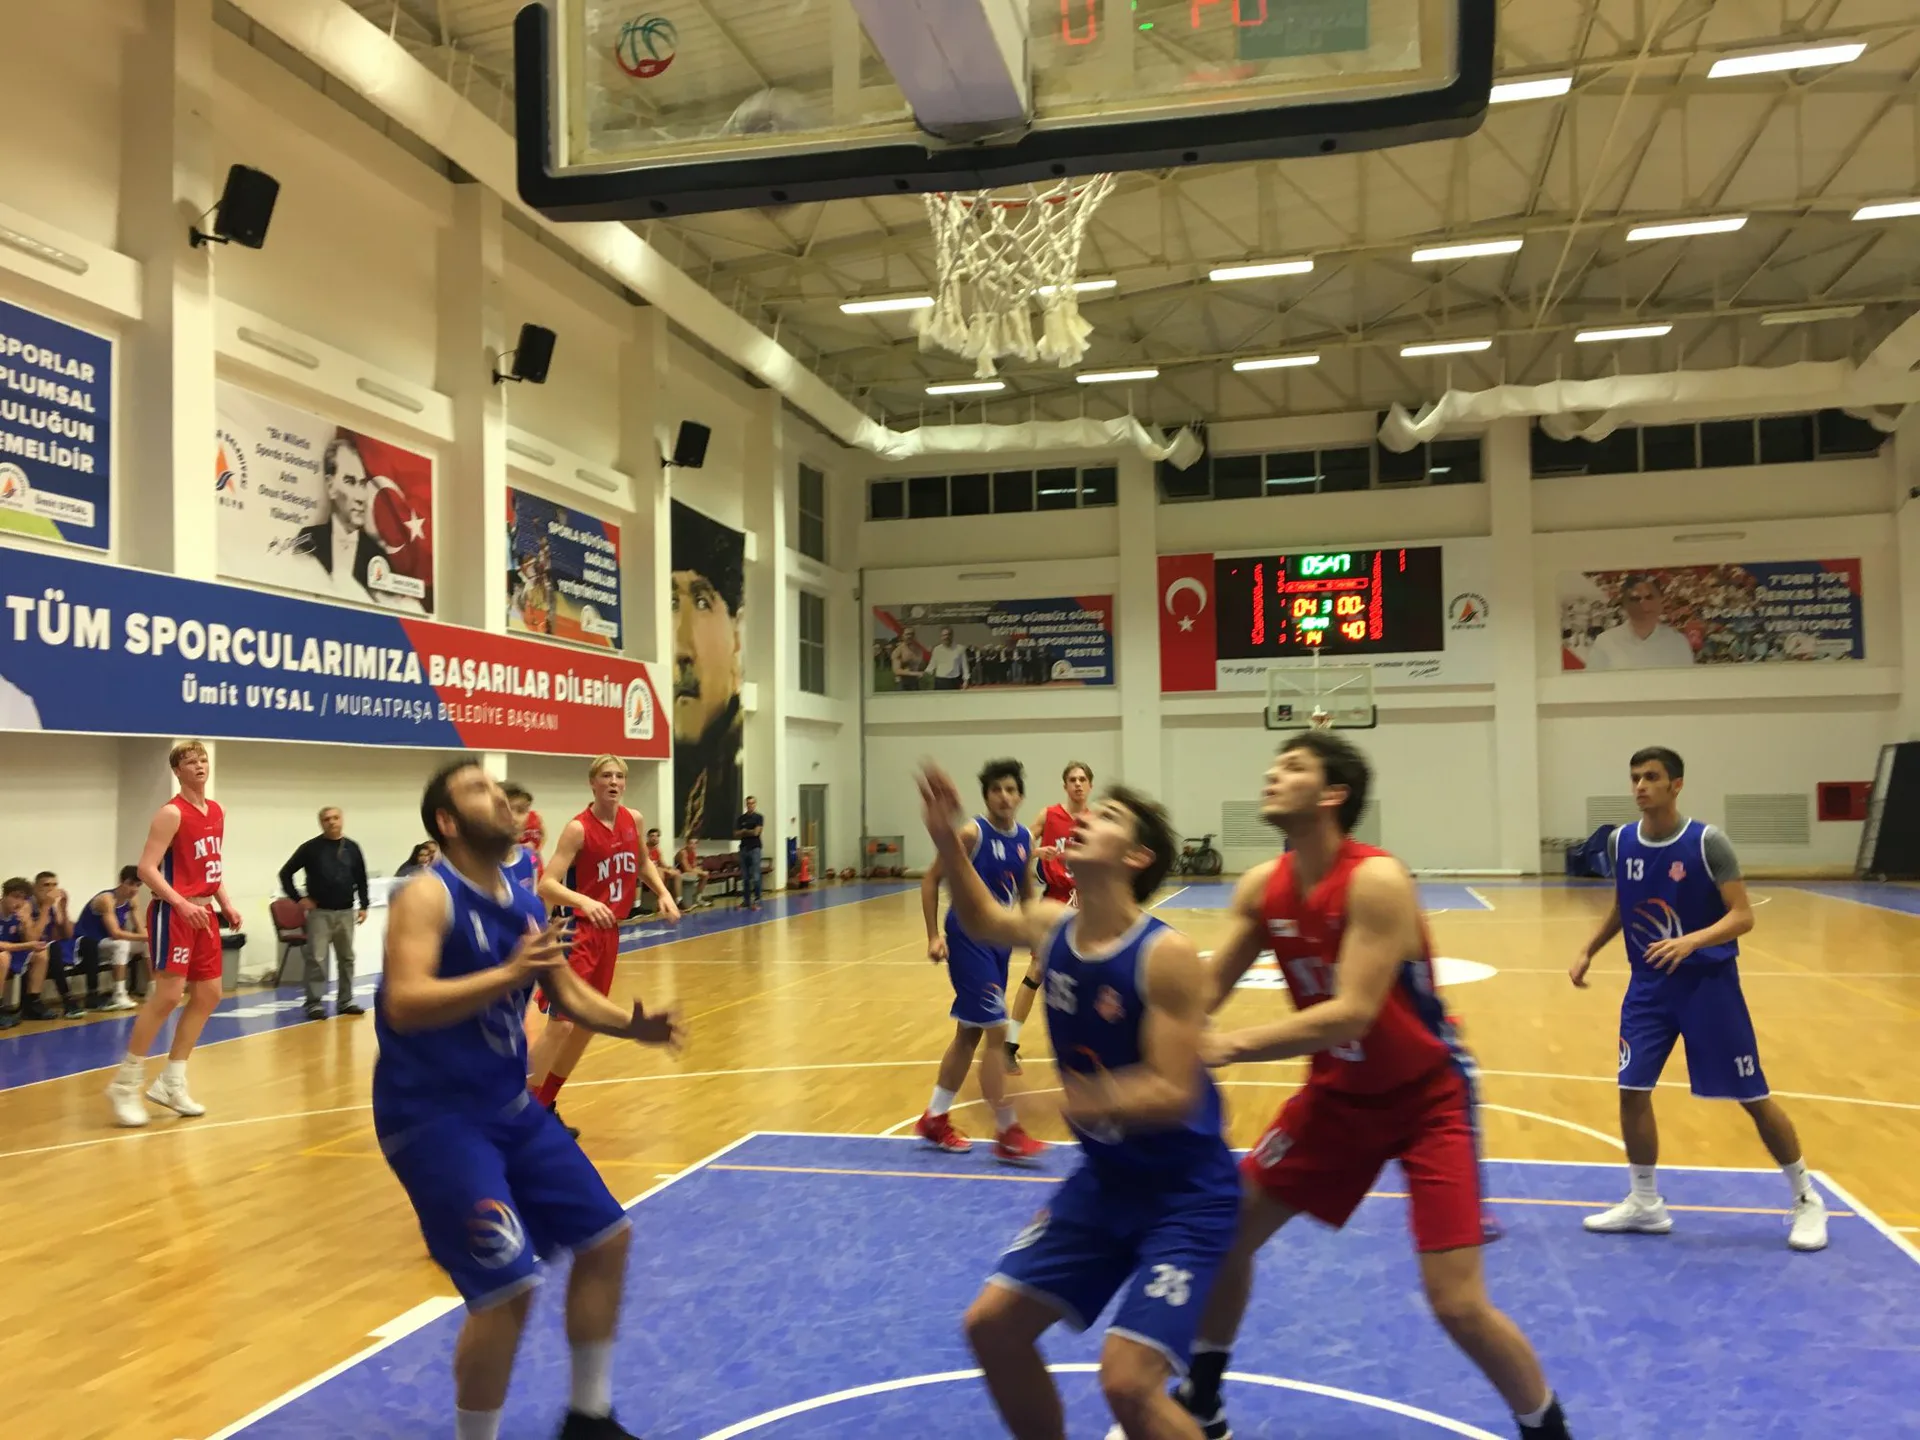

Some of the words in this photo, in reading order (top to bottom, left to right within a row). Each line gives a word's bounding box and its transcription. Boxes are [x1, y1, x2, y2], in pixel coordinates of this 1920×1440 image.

[0, 399, 95, 443] ULUĞUN
[5, 587, 111, 651] TÜM
[124, 612, 423, 685] SPORCULARIMIZA
[428, 653, 550, 700] BAŞARILAR
[554, 667, 623, 709] DİLERİM
[181, 672, 239, 707] Ümit
[245, 684, 315, 713] UYSAL
[334, 692, 434, 725] MURATPAŞA
[437, 701, 504, 726] BELEDİYE
[596, 851, 636, 883] NTG
[1625, 856, 1645, 882] 13
[172, 946, 190, 965] 22
[1733, 1054, 1756, 1078] 13
